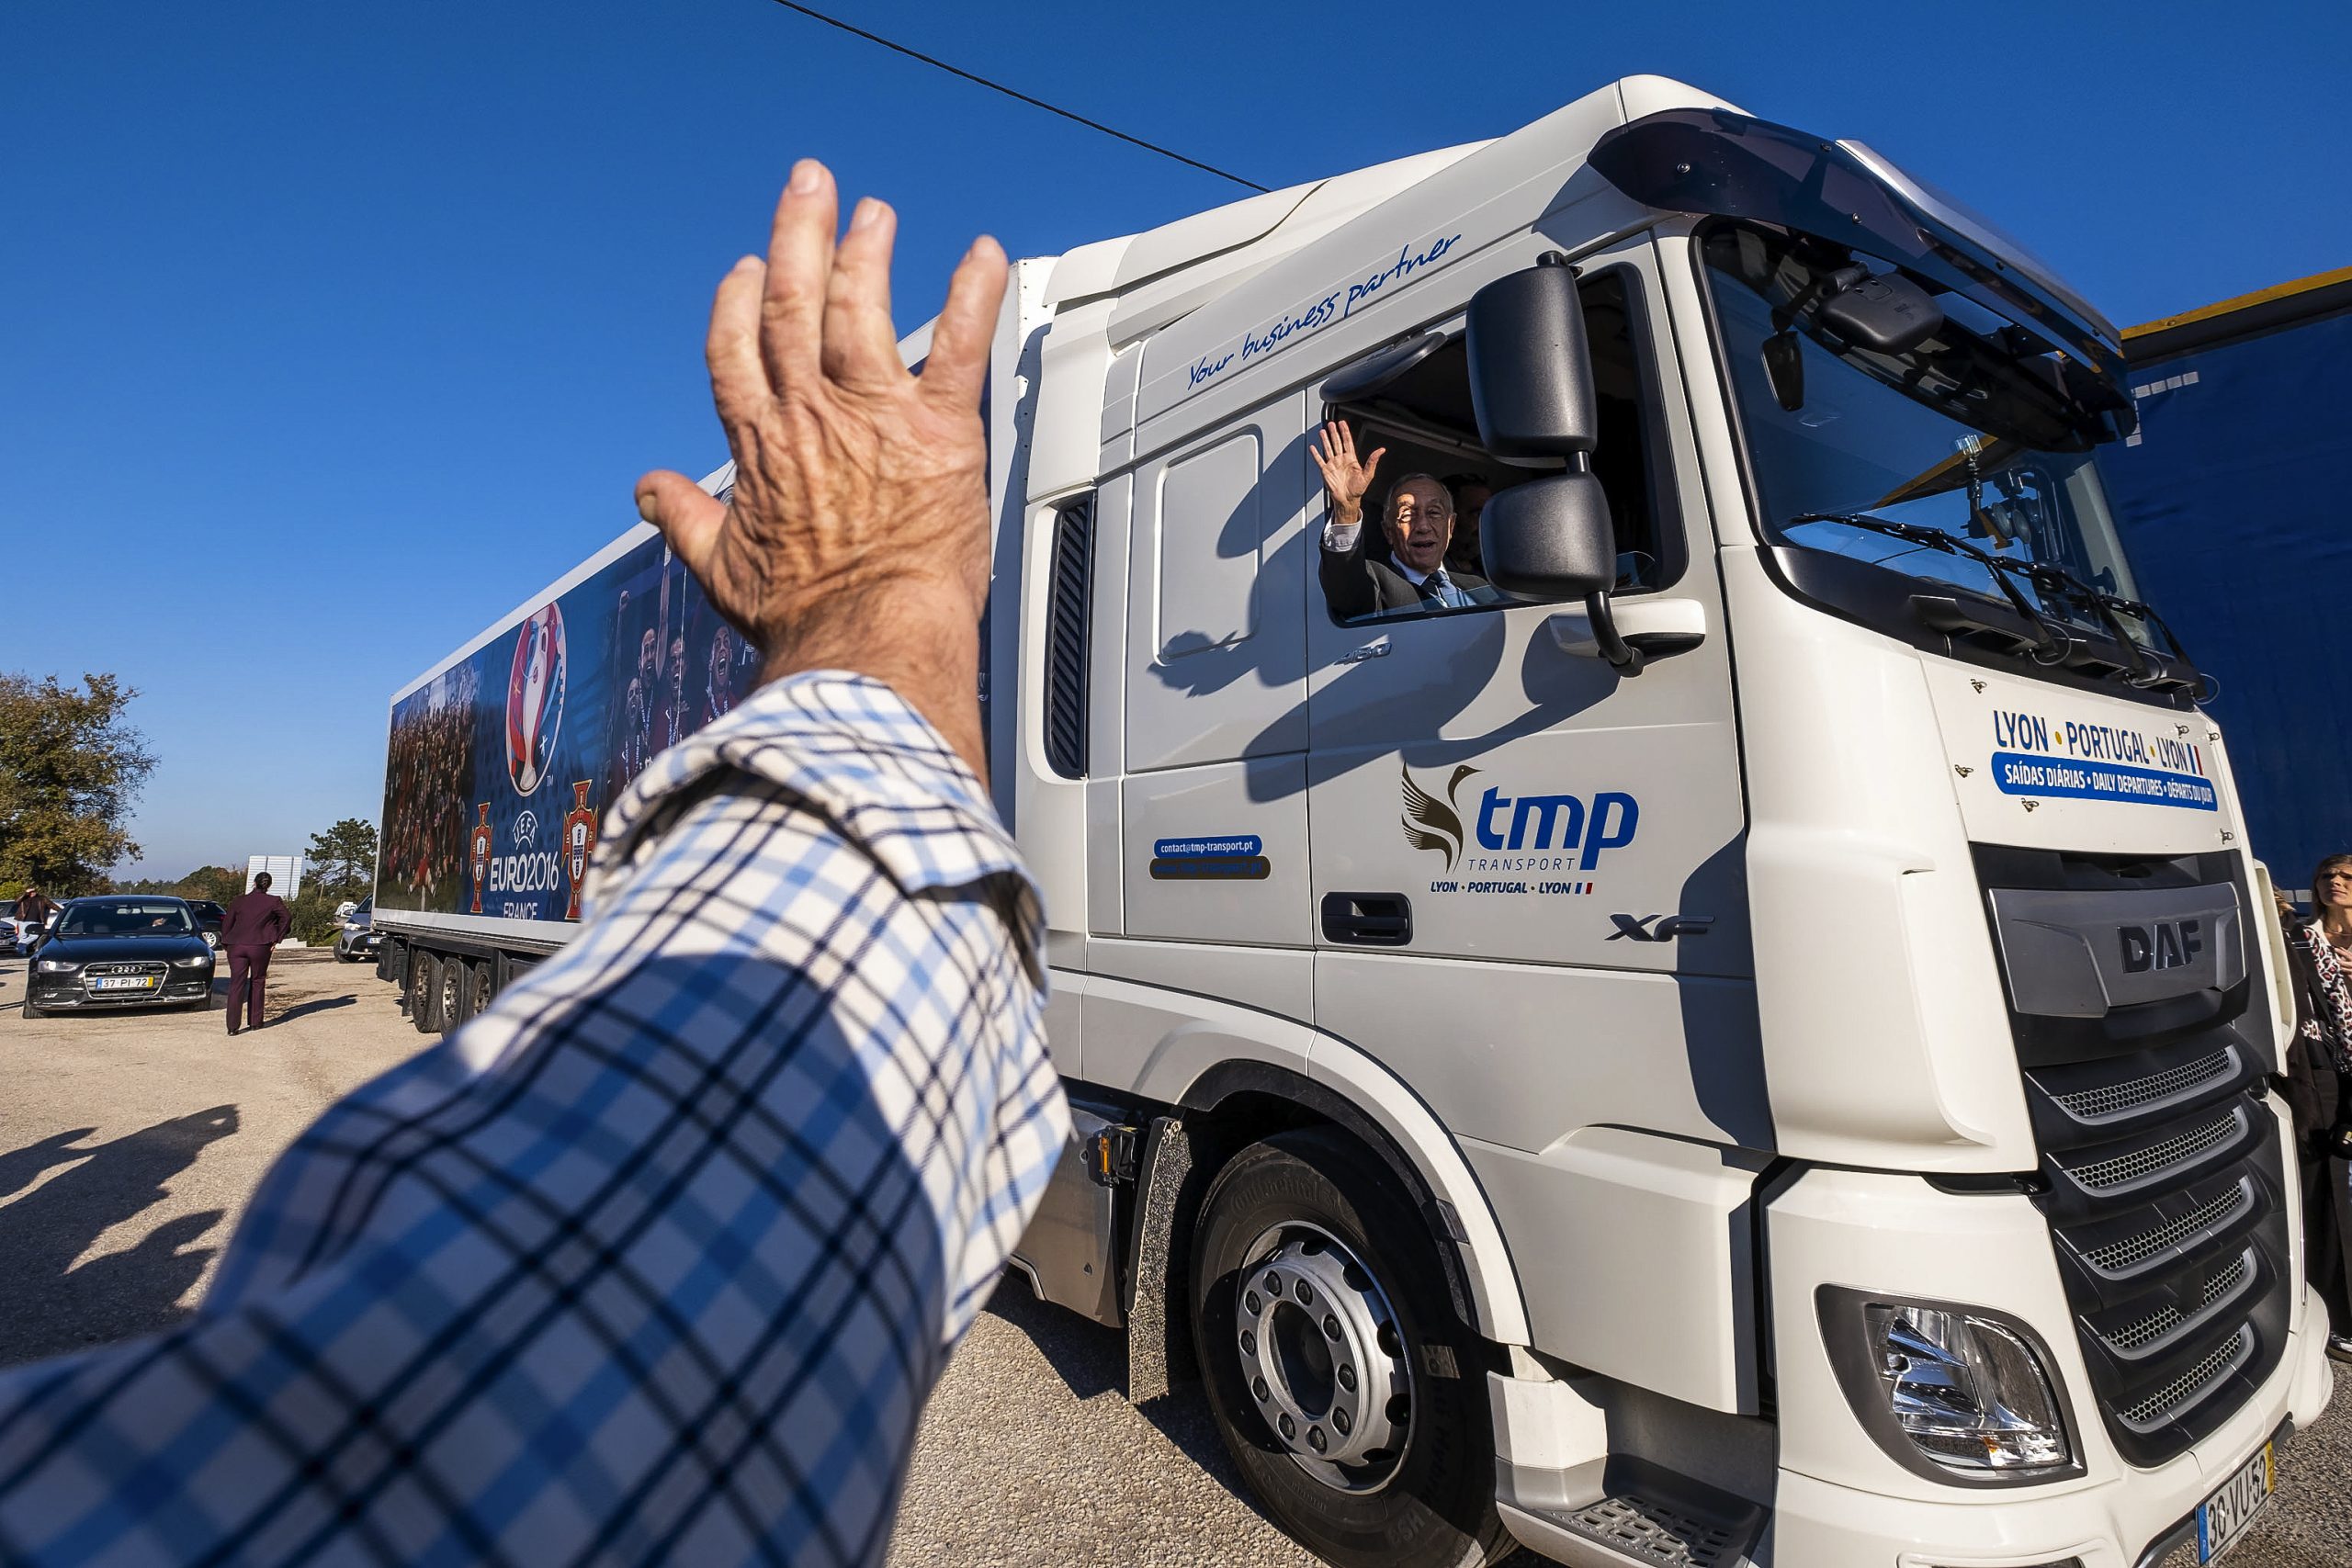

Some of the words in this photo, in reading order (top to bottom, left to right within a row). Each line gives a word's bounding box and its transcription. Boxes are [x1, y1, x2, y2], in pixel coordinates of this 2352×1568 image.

[1187, 353, 1235, 391] Your
[1241, 291, 1341, 361] business
[1343, 233, 1462, 319] partner
[1993, 709, 2049, 752] LYON
[2065, 721, 2150, 764] PORTUGAL
[2155, 736, 2188, 772] LYON
[2004, 760, 2045, 786] SAÍDAS
[2045, 763, 2086, 789] DIÁRIAS
[2092, 771, 2116, 792] DAILY
[2117, 774, 2164, 797] DEPARTURES
[514, 817, 536, 844] UEFA
[1476, 785, 1640, 871] tmp
[1160, 840, 1254, 854] contact@tmp-transport.pt
[1467, 857, 1576, 871] TRANSPORT
[1430, 880, 1459, 894] LYON
[1467, 881, 1528, 895] PORTUGAL
[1538, 882, 1572, 895] LYON
[503, 901, 538, 921] FRANCE
[1603, 913, 1716, 942] XF
[2116, 919, 2202, 974] DAF
